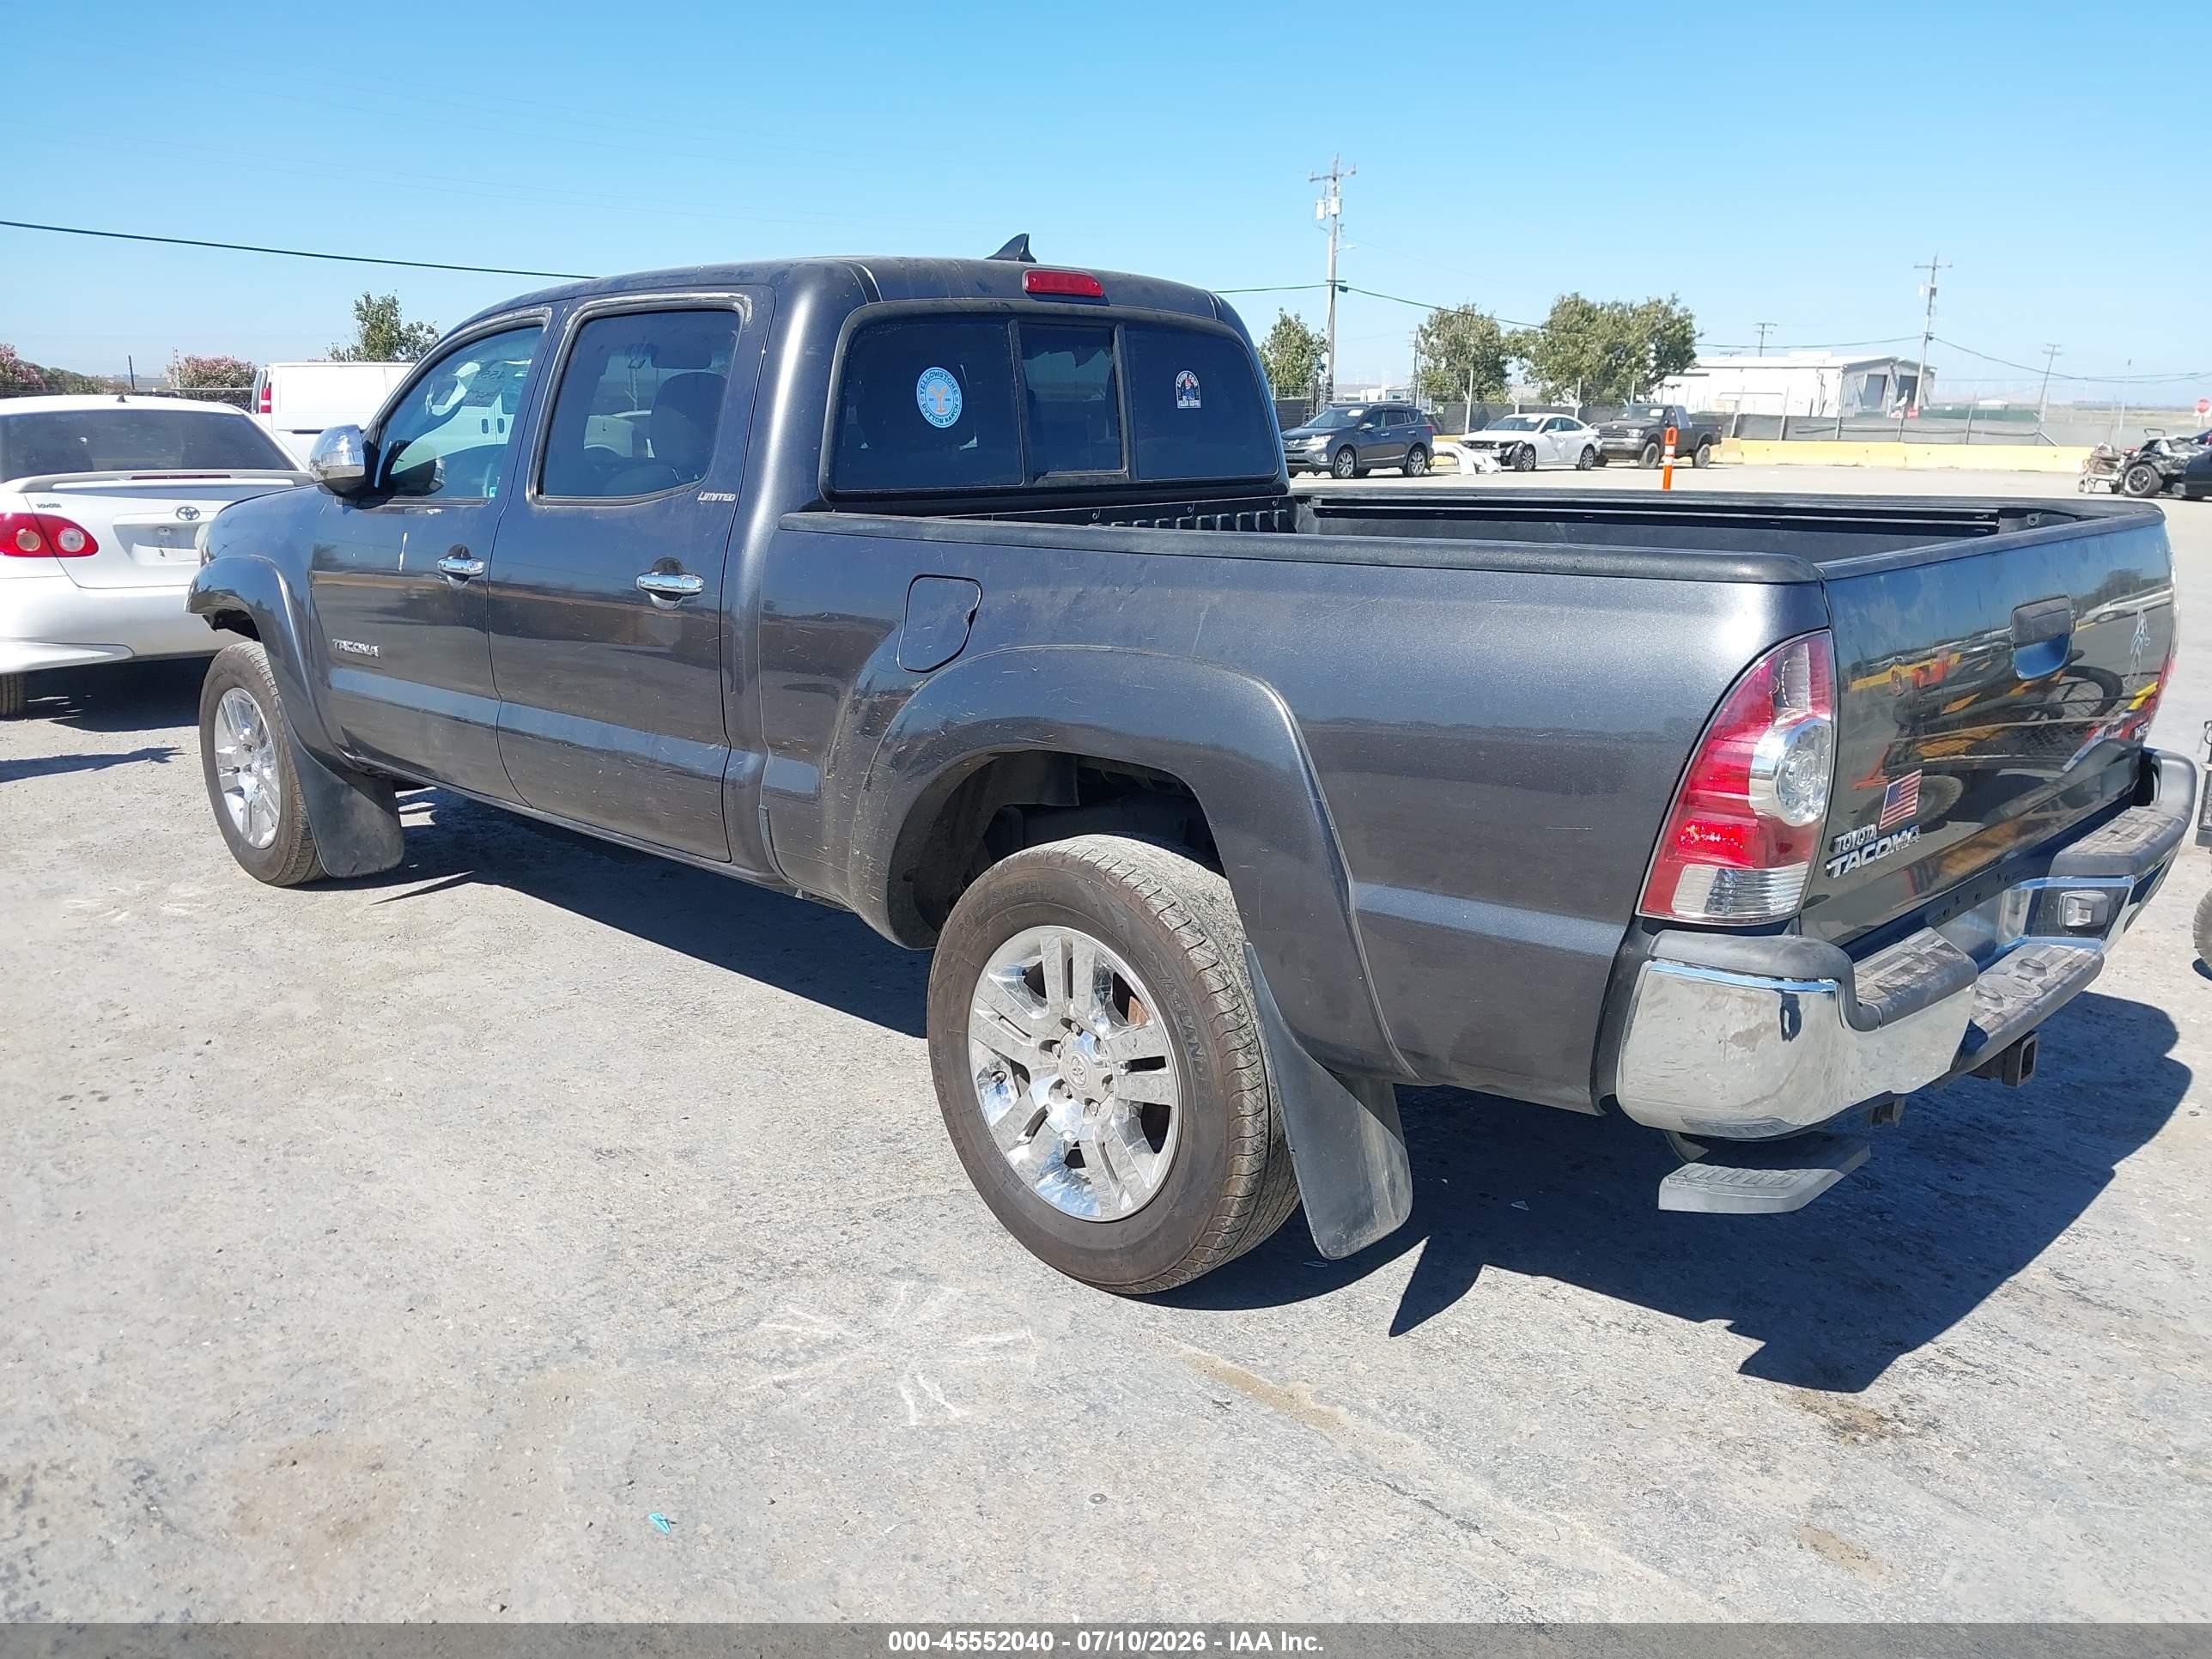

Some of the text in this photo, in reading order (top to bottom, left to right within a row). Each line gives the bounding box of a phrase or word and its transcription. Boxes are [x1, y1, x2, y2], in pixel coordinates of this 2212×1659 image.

[920, 369, 958, 395] YELLOWSTONE
[921, 404, 944, 424] DUTTON
[696, 490, 736, 501] LIMITED
[332, 638, 380, 658] TACOMA
[1830, 824, 1878, 854] TOYOTA
[1825, 825, 1921, 878] TACOMA
